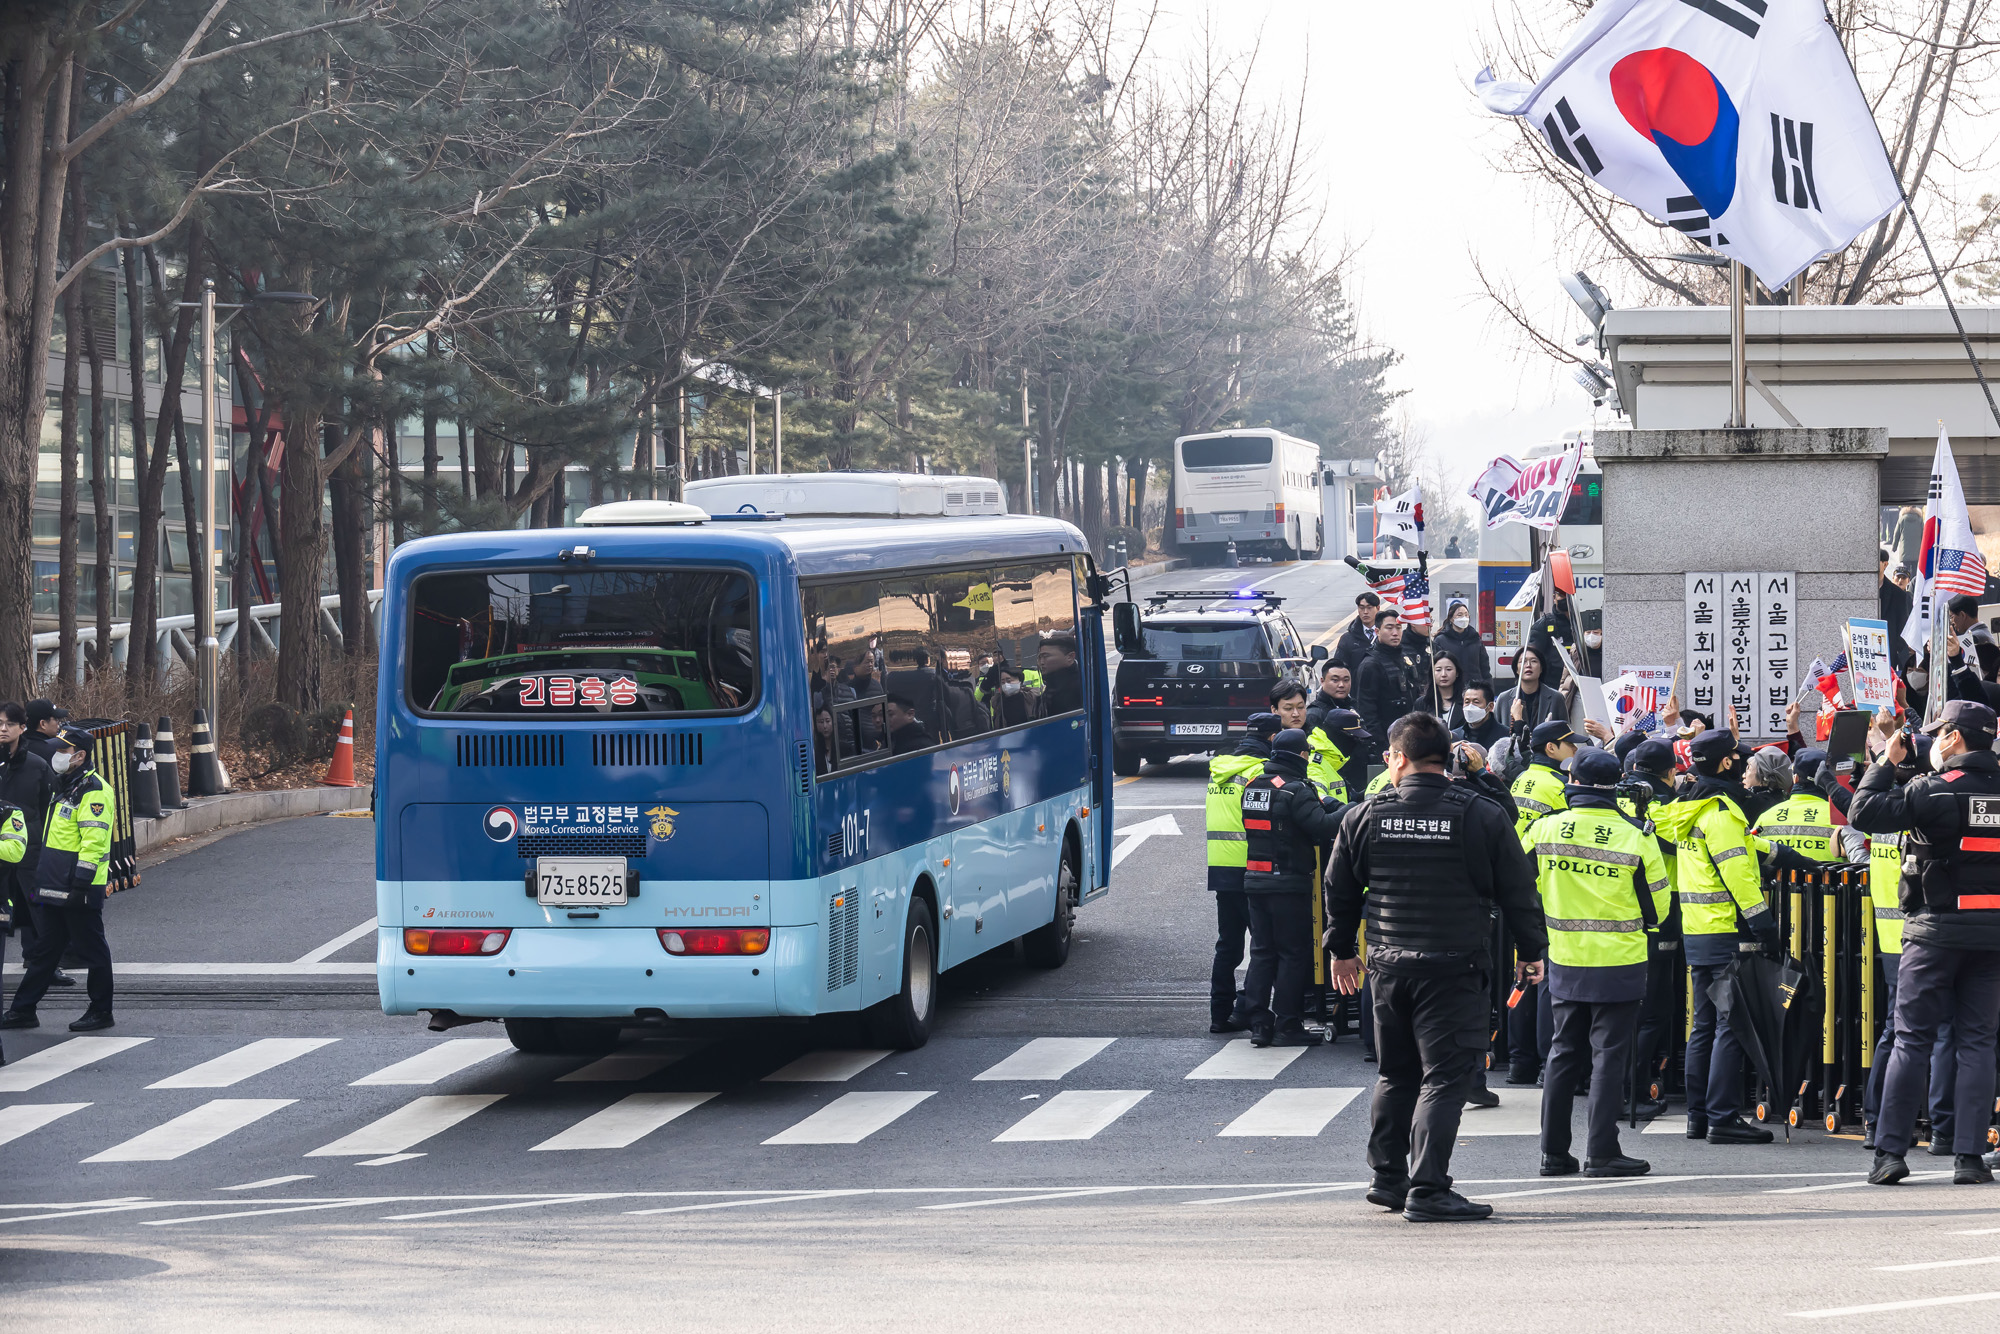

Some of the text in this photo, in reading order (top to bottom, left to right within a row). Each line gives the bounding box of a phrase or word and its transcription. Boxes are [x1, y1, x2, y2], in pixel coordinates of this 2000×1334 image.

[1576, 576, 1604, 588] LICE
[1693, 578, 1714, 729] 서울회생법
[1731, 578, 1751, 733] 서울중앙지방법원
[1768, 577, 1789, 732] 서울고등법원
[519, 676, 638, 706] 긴급호송
[963, 760, 978, 787] 법무부
[524, 806, 639, 824] 법무부 교정본부
[1381, 818, 1451, 832] 대한민국법원
[524, 824, 639, 834] Korea Correctional Service
[841, 809, 870, 858] 101-7
[1548, 859, 1619, 878] POLICE
[541, 875, 623, 896] 73도8525
[437, 906, 751, 919] AEROTOWN HYUNDAI
